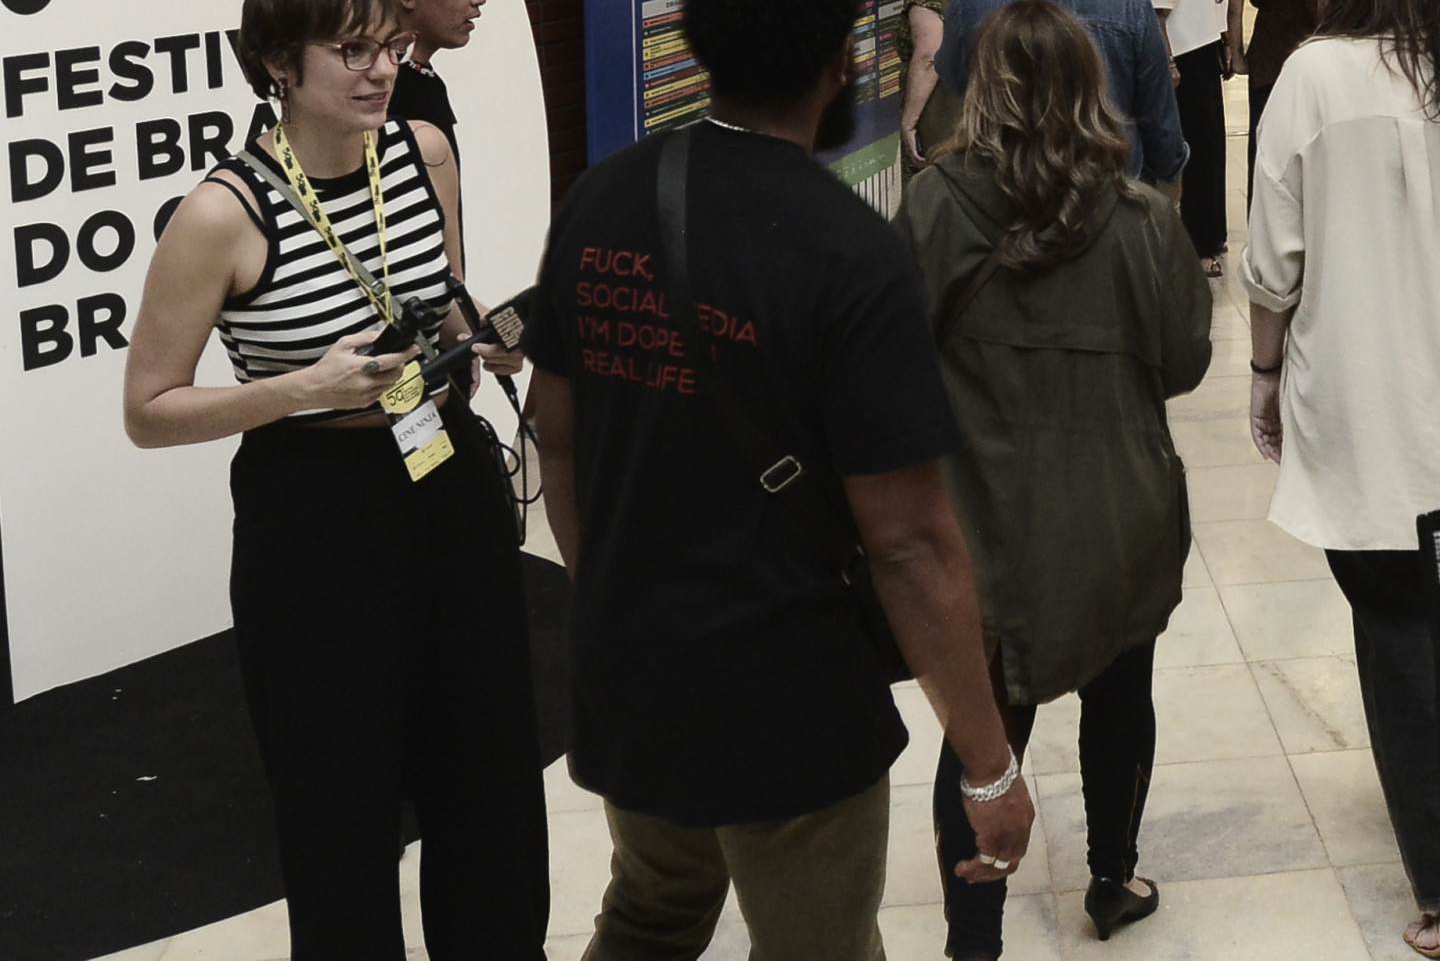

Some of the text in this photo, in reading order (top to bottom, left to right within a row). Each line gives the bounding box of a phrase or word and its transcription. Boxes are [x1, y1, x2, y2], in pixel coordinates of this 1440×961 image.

[8, 126, 118, 204] DE
[13, 209, 137, 289] DO
[576, 281, 758, 346] SOCIAL EDIA
[617, 320, 686, 358] DOPE
[583, 348, 643, 382] REAL
